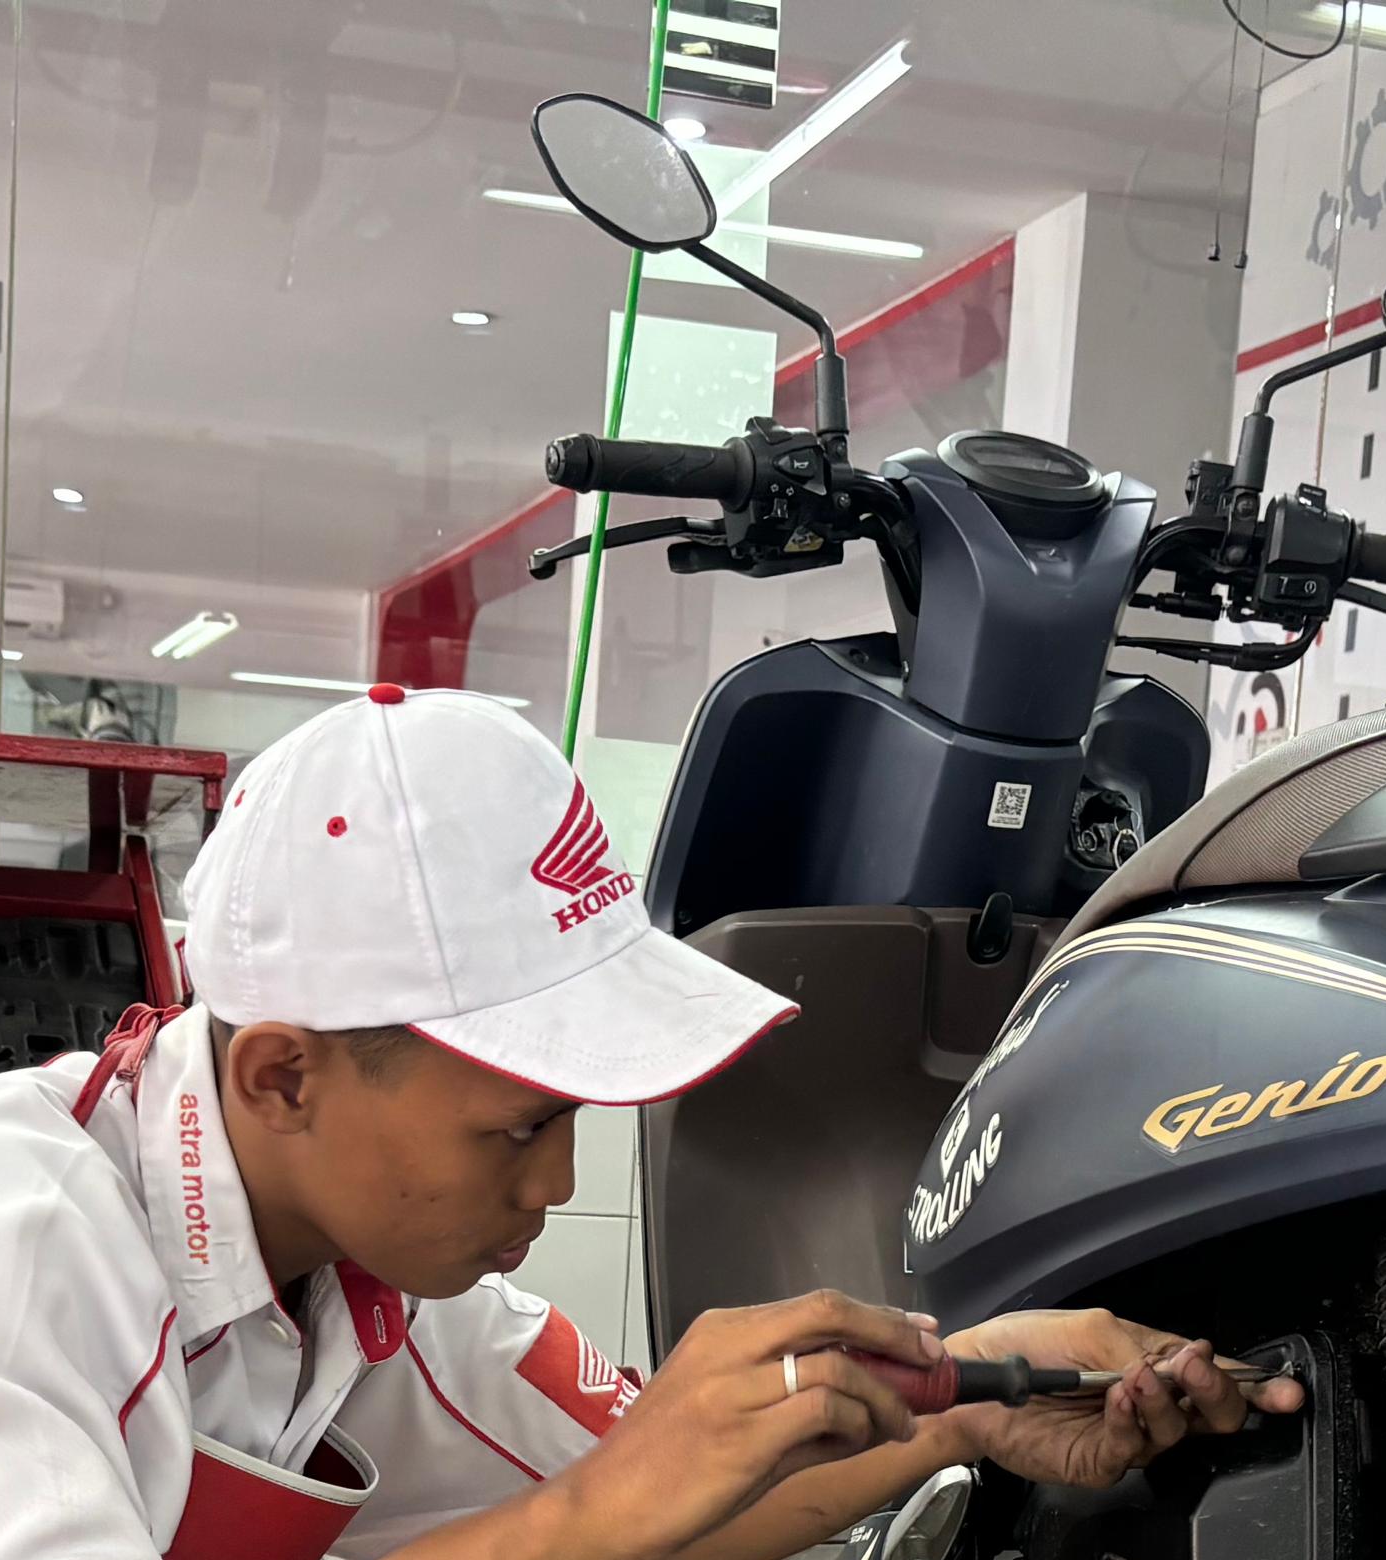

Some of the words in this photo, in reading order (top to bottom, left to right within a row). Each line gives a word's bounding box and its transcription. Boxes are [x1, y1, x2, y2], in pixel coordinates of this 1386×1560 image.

[551, 872, 636, 933] HOND
[179, 1094, 203, 1168] astra
[182, 1175, 211, 1265] motor
